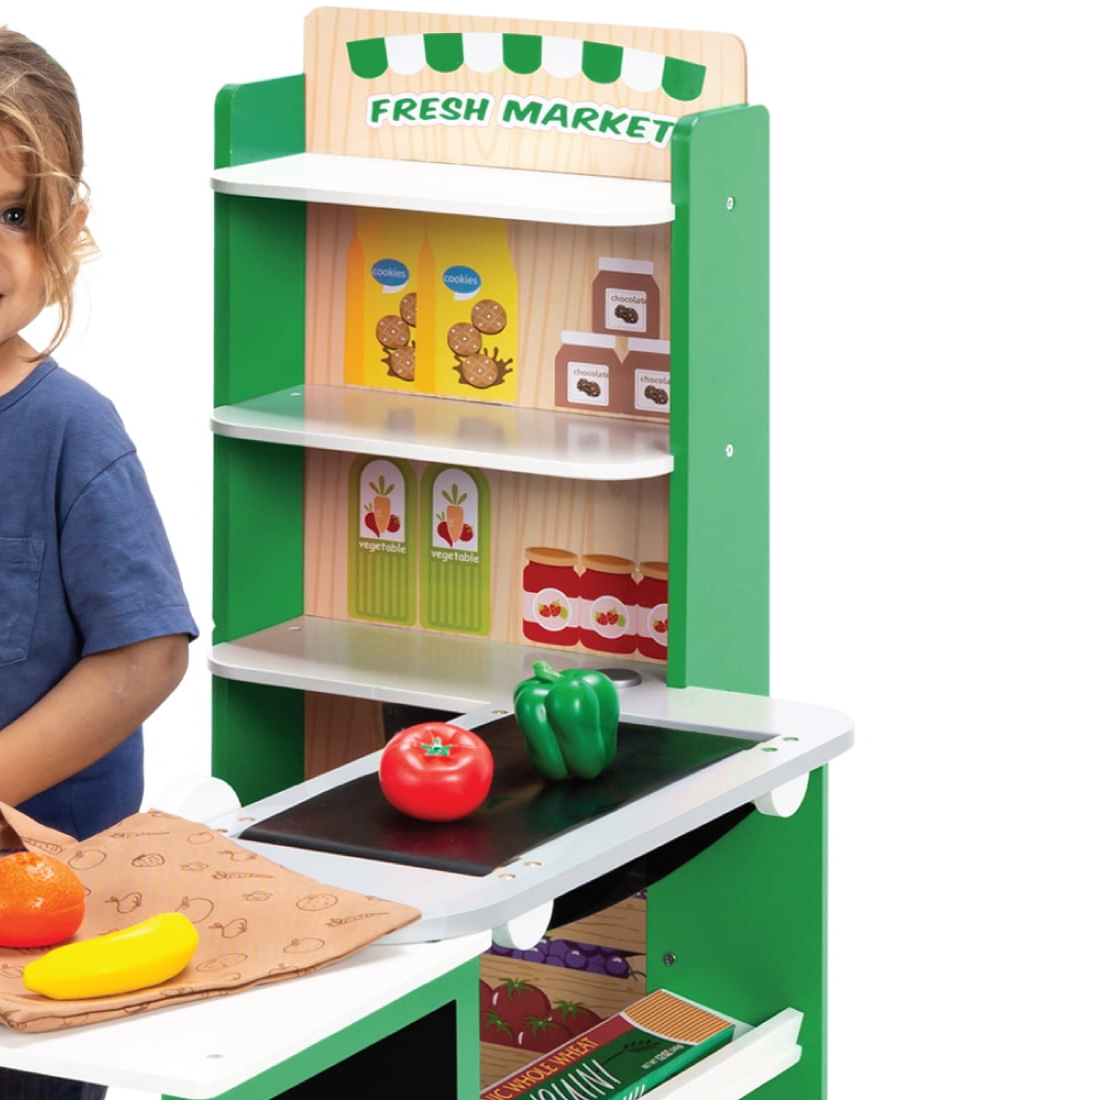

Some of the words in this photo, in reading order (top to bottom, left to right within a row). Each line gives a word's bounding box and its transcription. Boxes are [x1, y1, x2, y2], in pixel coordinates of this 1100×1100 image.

[371, 97, 490, 123] FRESH
[502, 99, 675, 143] MARKET
[372, 267, 407, 279] cookies
[443, 273, 478, 286] cookies
[359, 541, 407, 554] vegetable
[431, 549, 480, 563] vegetable
[503, 1062, 559, 1092] WHOLE
[549, 1036, 599, 1066] WHEAT
